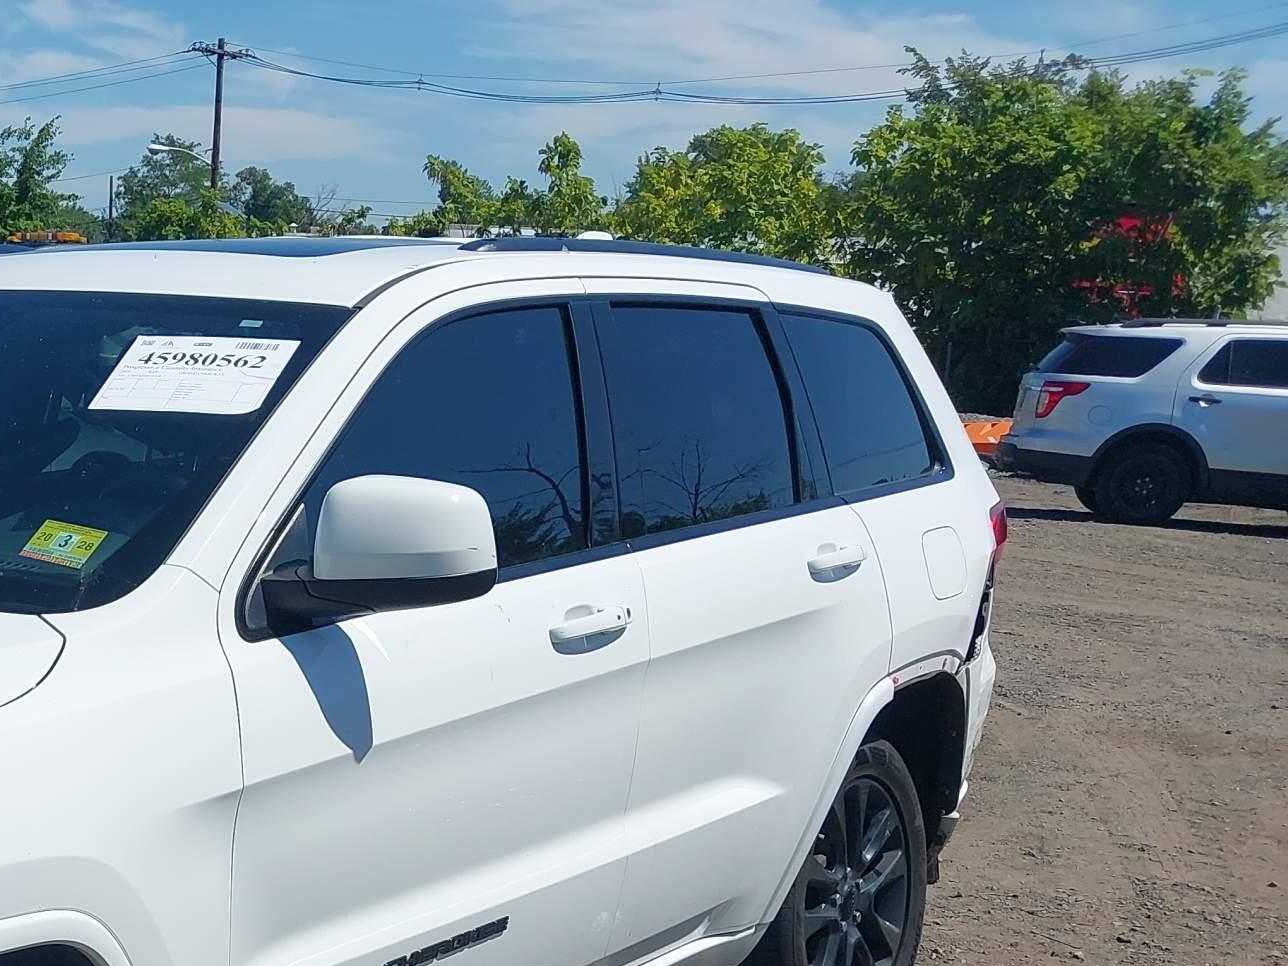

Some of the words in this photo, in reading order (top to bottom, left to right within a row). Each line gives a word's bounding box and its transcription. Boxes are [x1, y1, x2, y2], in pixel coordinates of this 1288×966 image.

[137, 351, 267, 369] 45980562
[36, 531, 54, 542] 20
[58, 534, 73, 548] 3
[76, 540, 95, 551] 28
